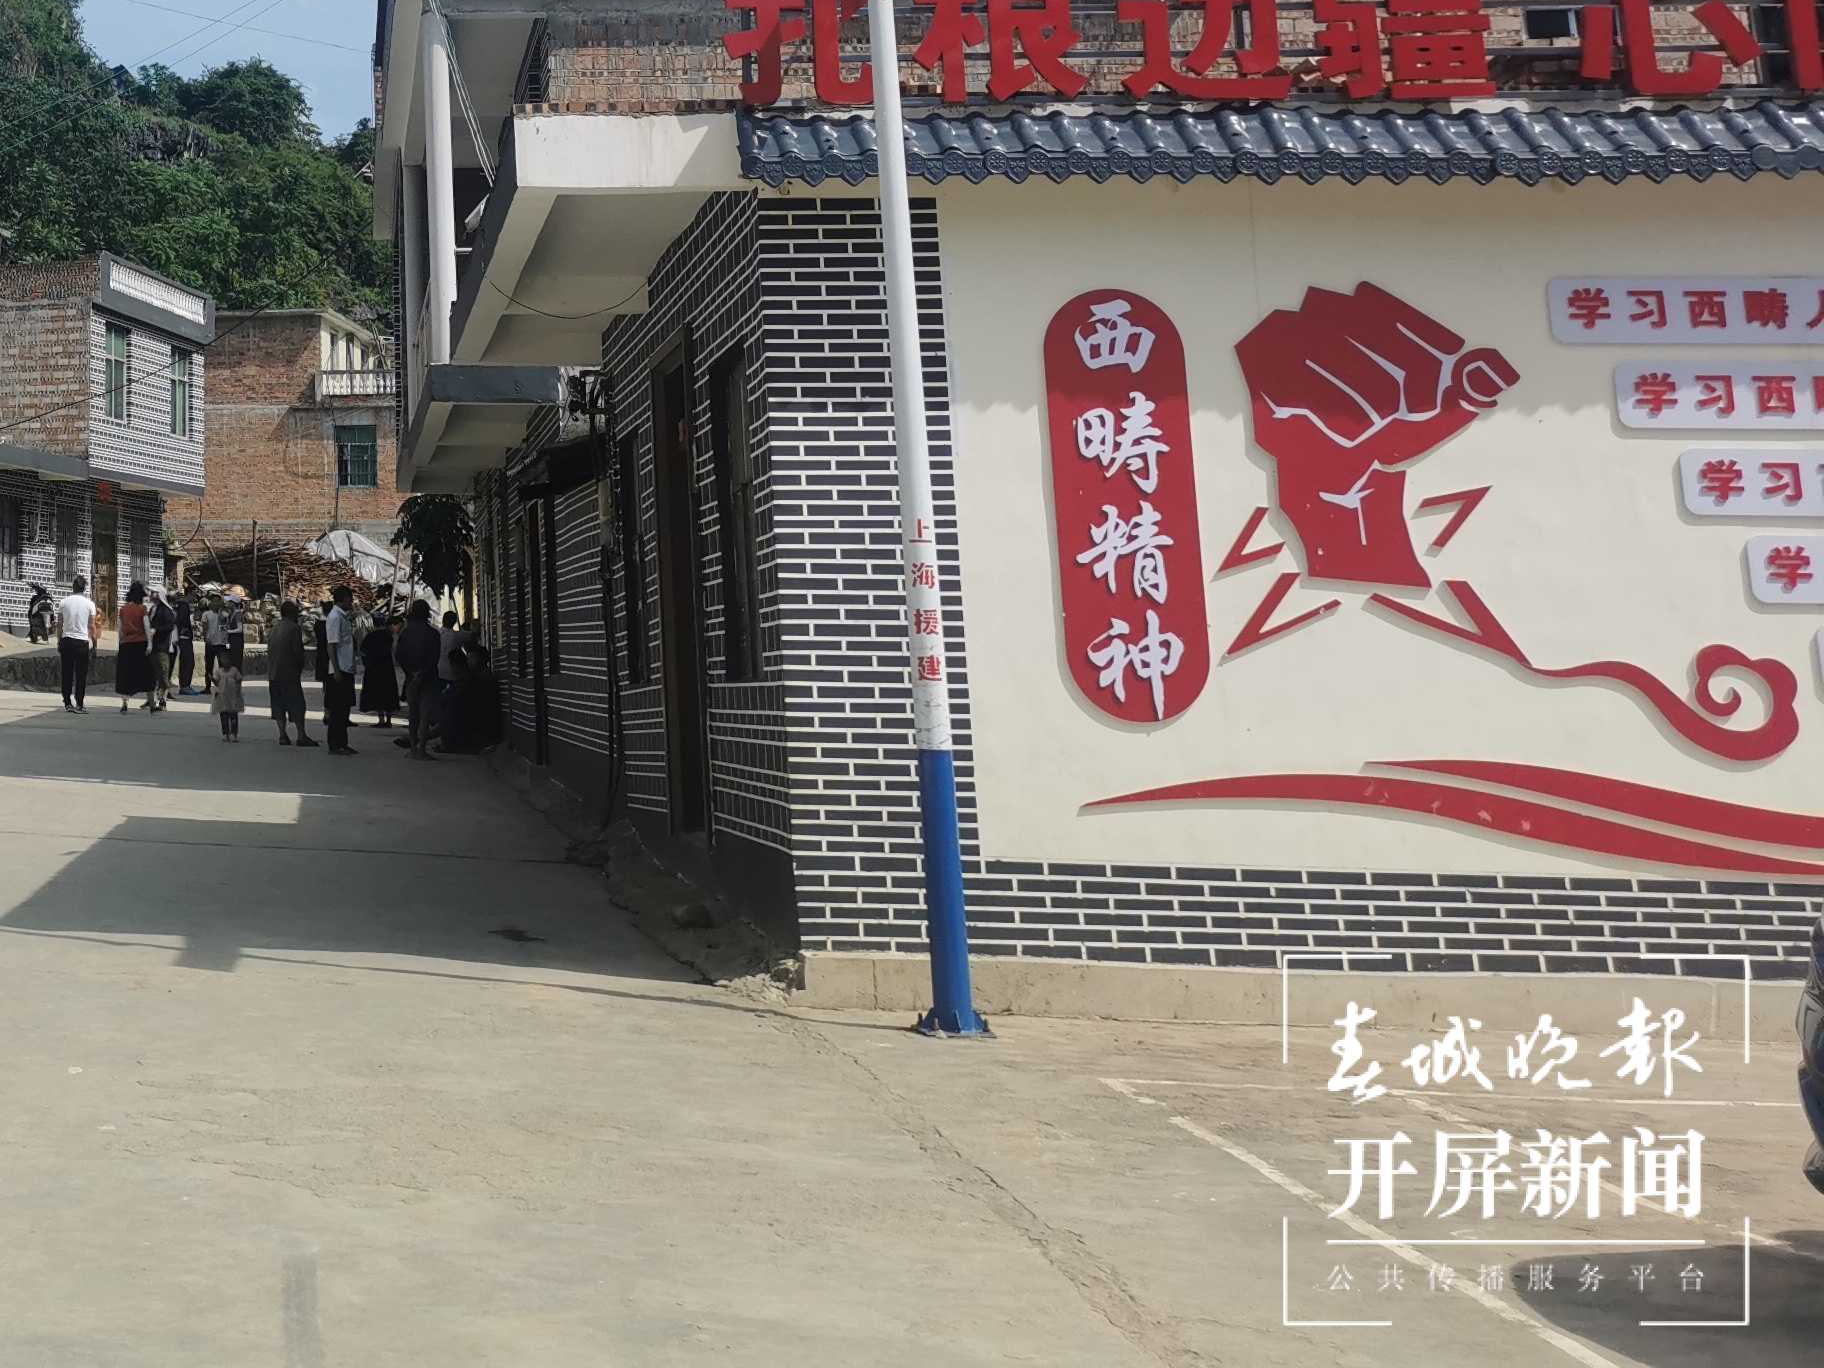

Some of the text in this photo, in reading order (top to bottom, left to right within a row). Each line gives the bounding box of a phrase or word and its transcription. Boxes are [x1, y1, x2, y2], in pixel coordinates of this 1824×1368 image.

[1633, 372, 1824, 415] 学习西
[1698, 459, 1824, 504] 学习
[1073, 299, 1185, 721] 西畴精神
[1767, 545, 1814, 591] 学
[908, 518, 943, 682] 上海援建
